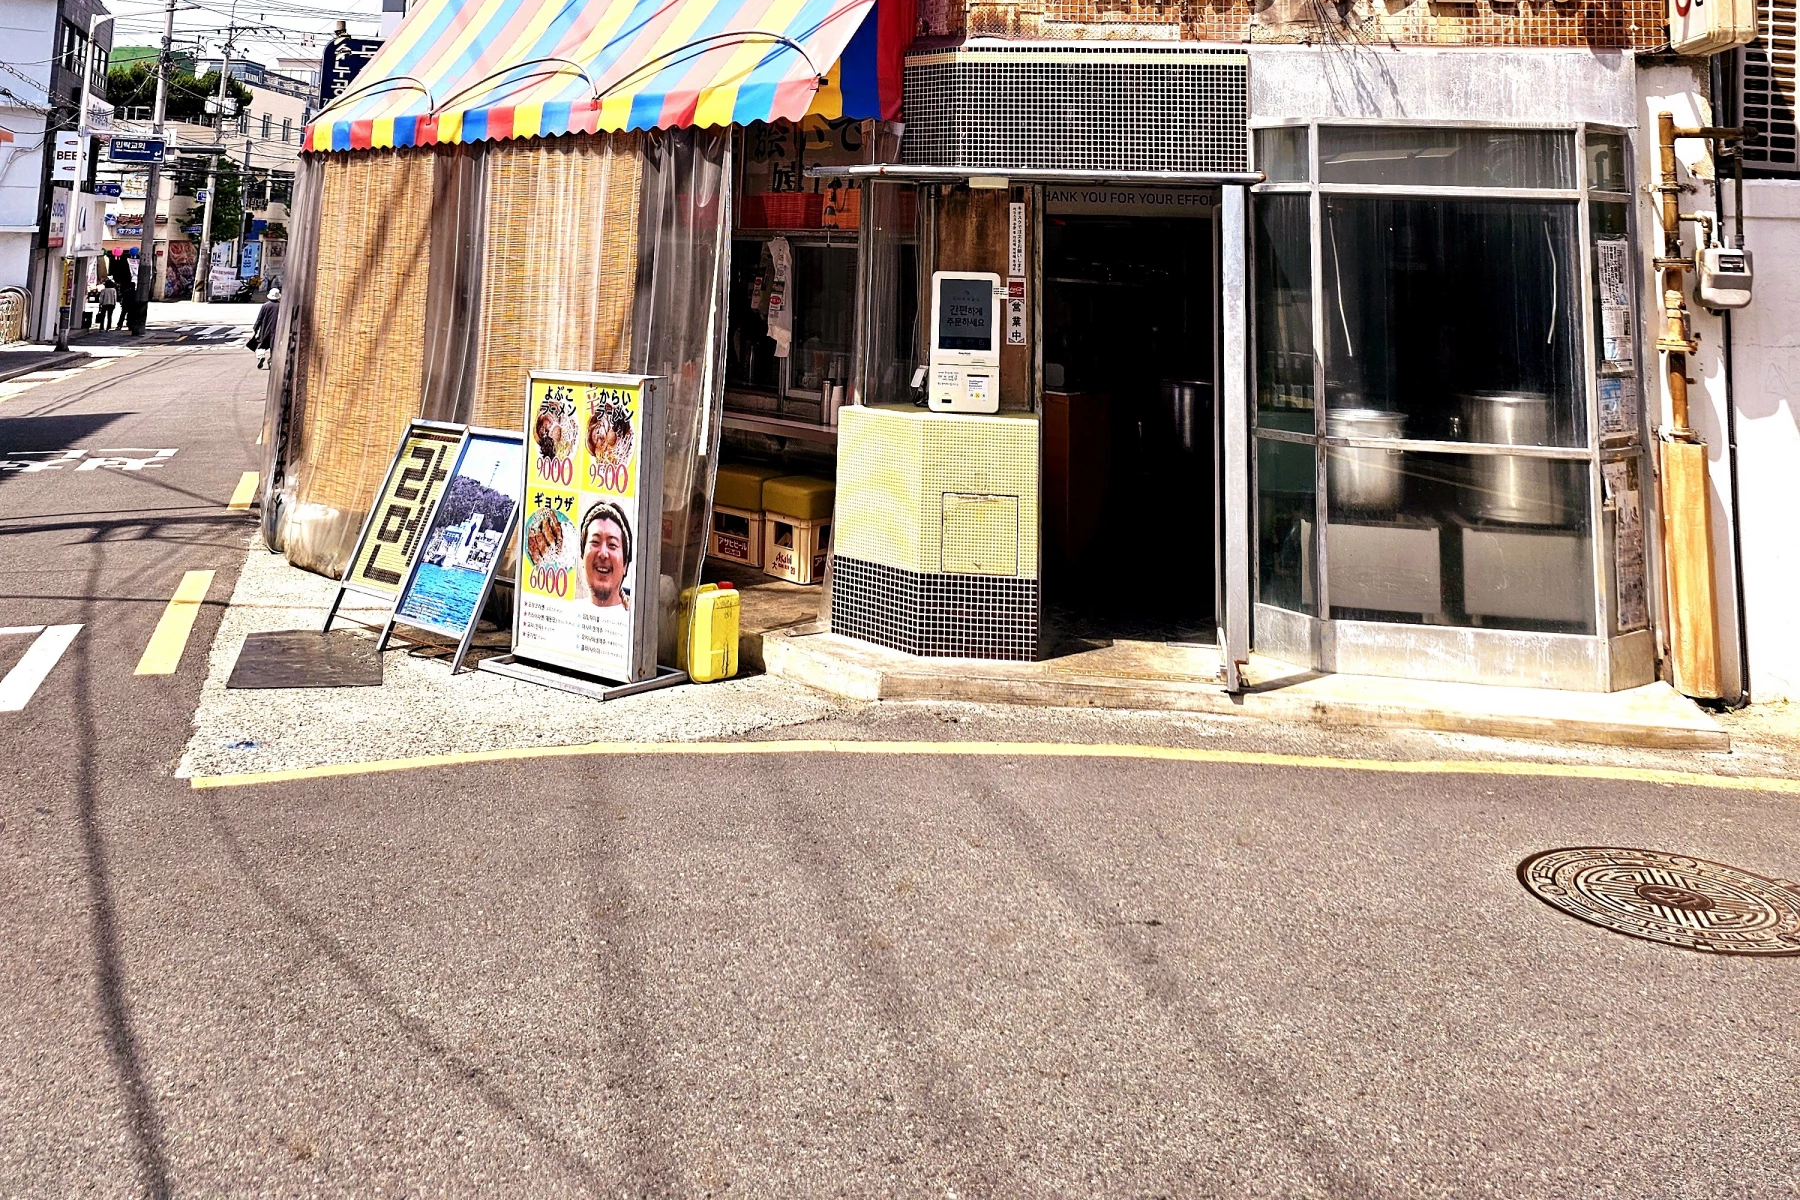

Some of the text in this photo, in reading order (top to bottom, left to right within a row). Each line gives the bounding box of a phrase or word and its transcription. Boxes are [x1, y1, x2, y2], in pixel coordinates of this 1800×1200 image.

[1081, 192, 1106, 203] YOU
[1111, 192, 1135, 204] FOR
[1139, 193, 1173, 204] YOUR
[950, 305, 983, 316] 간편하게
[947, 317, 985, 327] 주문하세요
[1011, 301, 1021, 341] 営業中
[545, 386, 574, 402] よぶこ
[600, 389, 631, 406] からい
[541, 401, 576, 417] ラーメン
[596, 405, 634, 421] ラーメン
[537, 457, 573, 486] 9000
[589, 464, 628, 493] 9500
[534, 492, 574, 512] ギョウザ
[718, 537, 747, 551] アサヒビール
[530, 567, 567, 597] 6000
